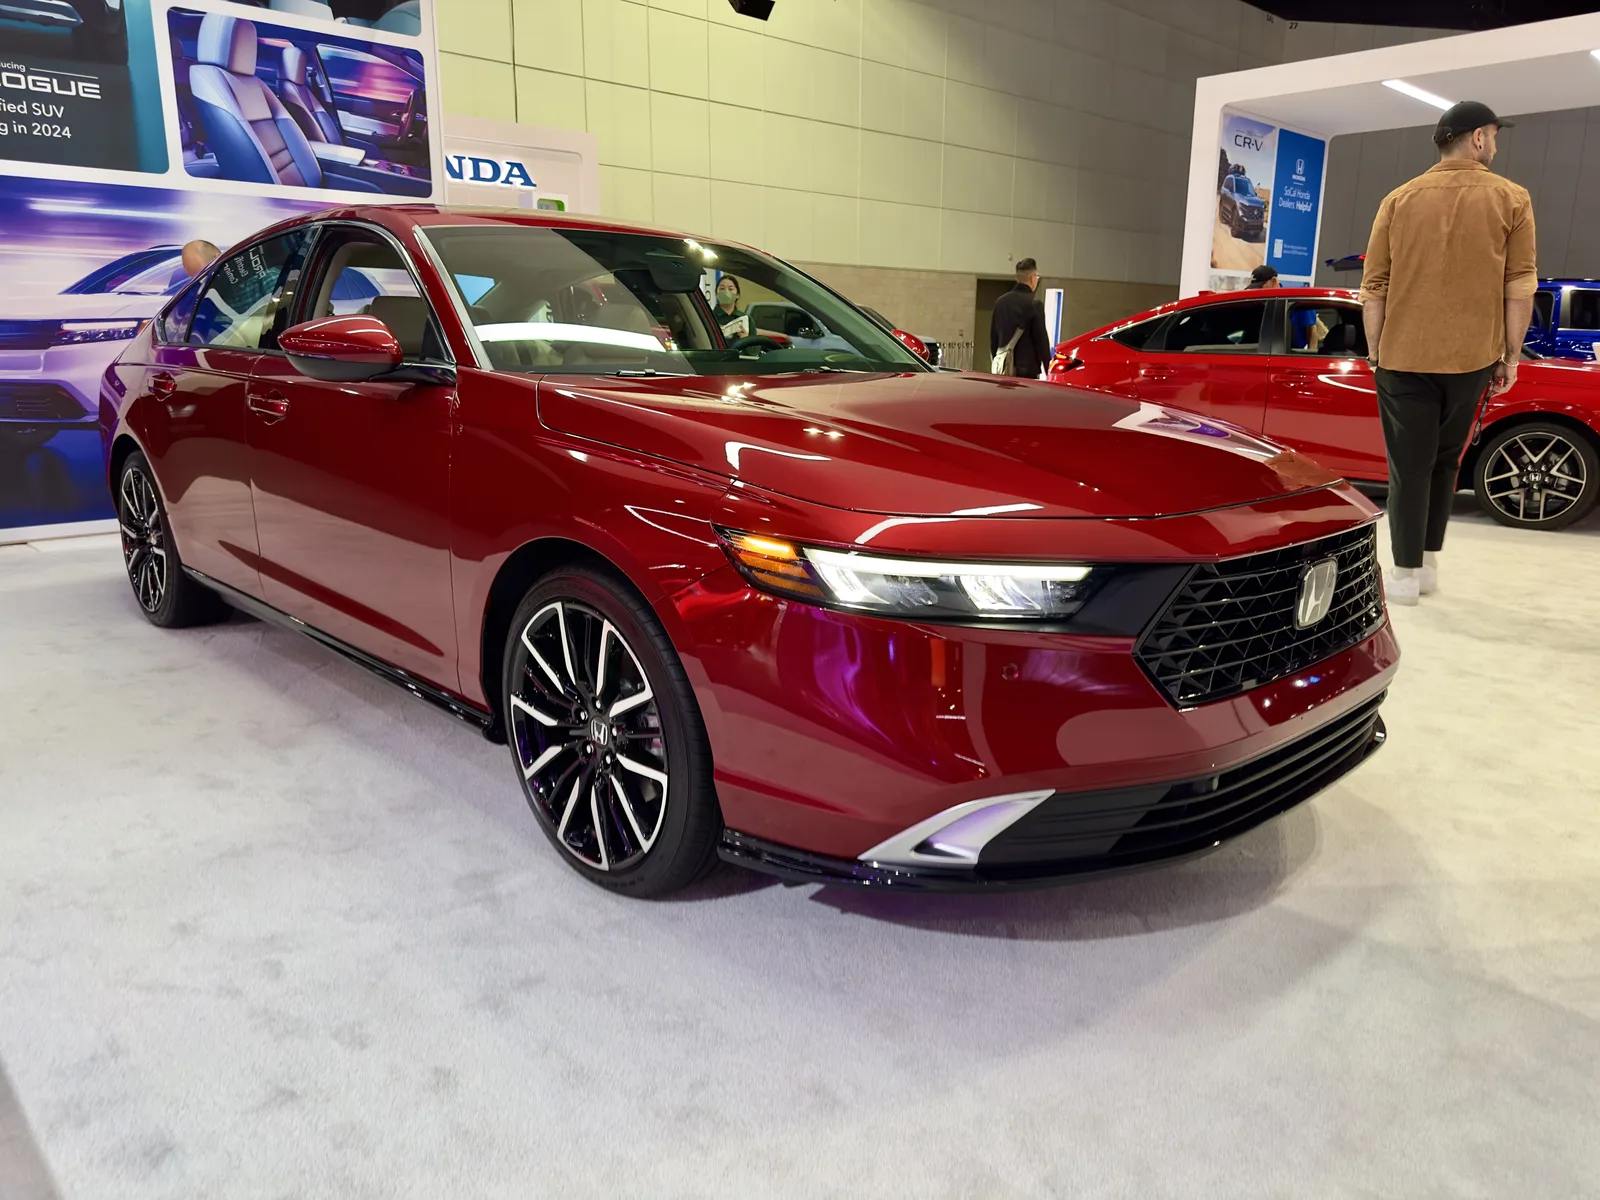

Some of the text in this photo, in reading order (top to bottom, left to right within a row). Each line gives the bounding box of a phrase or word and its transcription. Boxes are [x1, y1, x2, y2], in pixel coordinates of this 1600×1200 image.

[0, 61, 26, 73] ucing
[0, 72, 101, 100] OGUE
[31, 102, 65, 118] SUV
[12, 120, 28, 135] in
[31, 122, 72, 139] 2024
[1284, 186, 1311, 200] SoCal Honda
